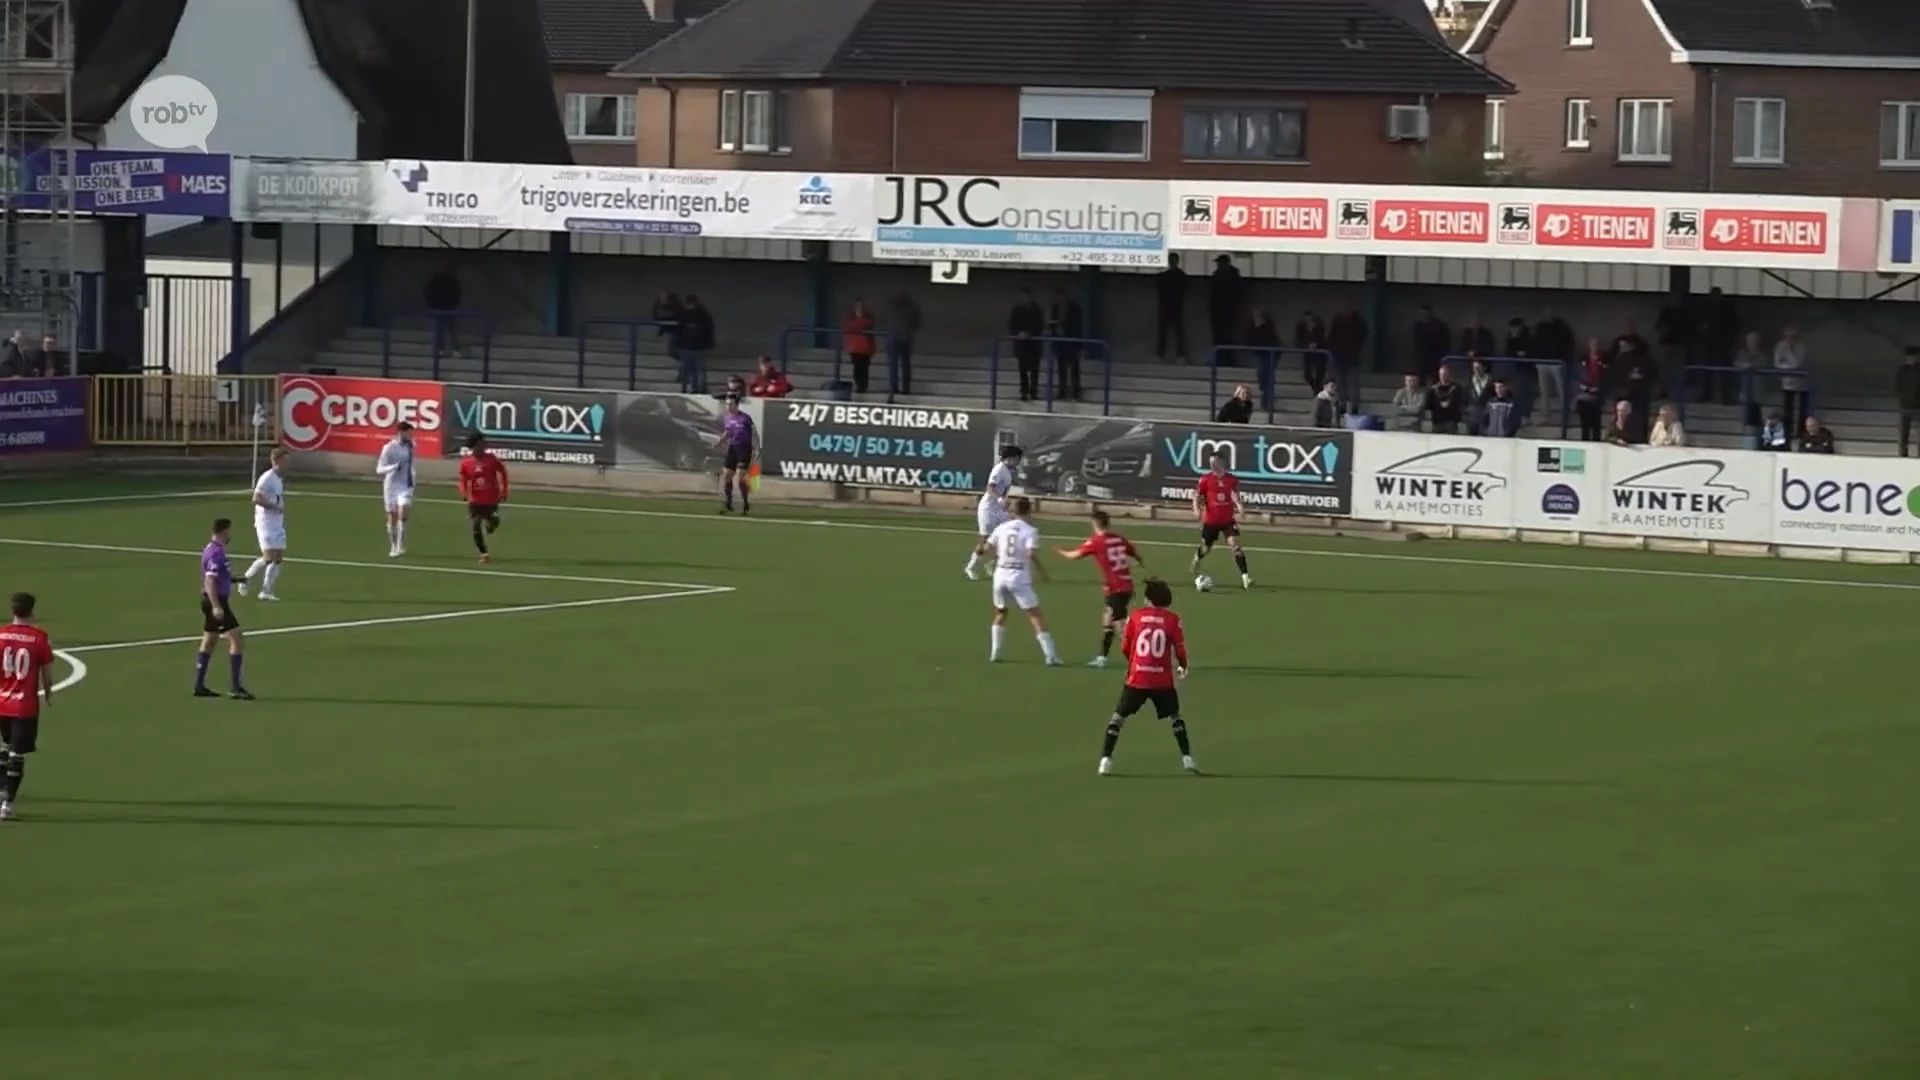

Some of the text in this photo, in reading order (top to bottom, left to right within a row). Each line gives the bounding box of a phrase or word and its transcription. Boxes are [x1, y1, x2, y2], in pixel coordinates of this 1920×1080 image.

[93, 160, 158, 176] ONE TEAM.
[181, 175, 226, 193] MAES
[258, 174, 360, 197] DE KOOKPOT
[97, 189, 160, 205] ONE BEER.
[426, 191, 478, 208] TRIGO
[520, 184, 749, 218] trigoverzekeringen.be
[1222, 205, 1323, 230] AD TIENEN
[1380, 209, 1483, 235] AD TIENEN
[1542, 213, 1649, 240] AD TIENEN
[1710, 218, 1821, 246] AD TIENEN
[942, 261, 959, 280] J
[223, 382, 233, 399] 1
[321, 395, 440, 430] CROES
[454, 394, 517, 431] vlm
[788, 404, 970, 431] 24/7 BESCHIKBAAR
[544, 451, 595, 465] BUSINESS
[809, 433, 945, 458] 0479/ 50 71 84
[1165, 431, 1237, 473] vlm
[780, 461, 973, 489] WWW.VLMTAX.COM
[1376, 476, 1485, 500] WINTEK
[1374, 500, 1483, 517] RAAMEMOTIES
[1612, 489, 1726, 514] WINTEK
[1611, 513, 1725, 530] RAAMEMOTIES
[1780, 519, 1837, 533] connecting
[1839, 521, 1883, 534] nutrition
[1885, 523, 1905, 535] and
[1007, 533, 1018, 556] 8
[1107, 545, 1129, 571] 55
[1136, 628, 1167, 658] 60
